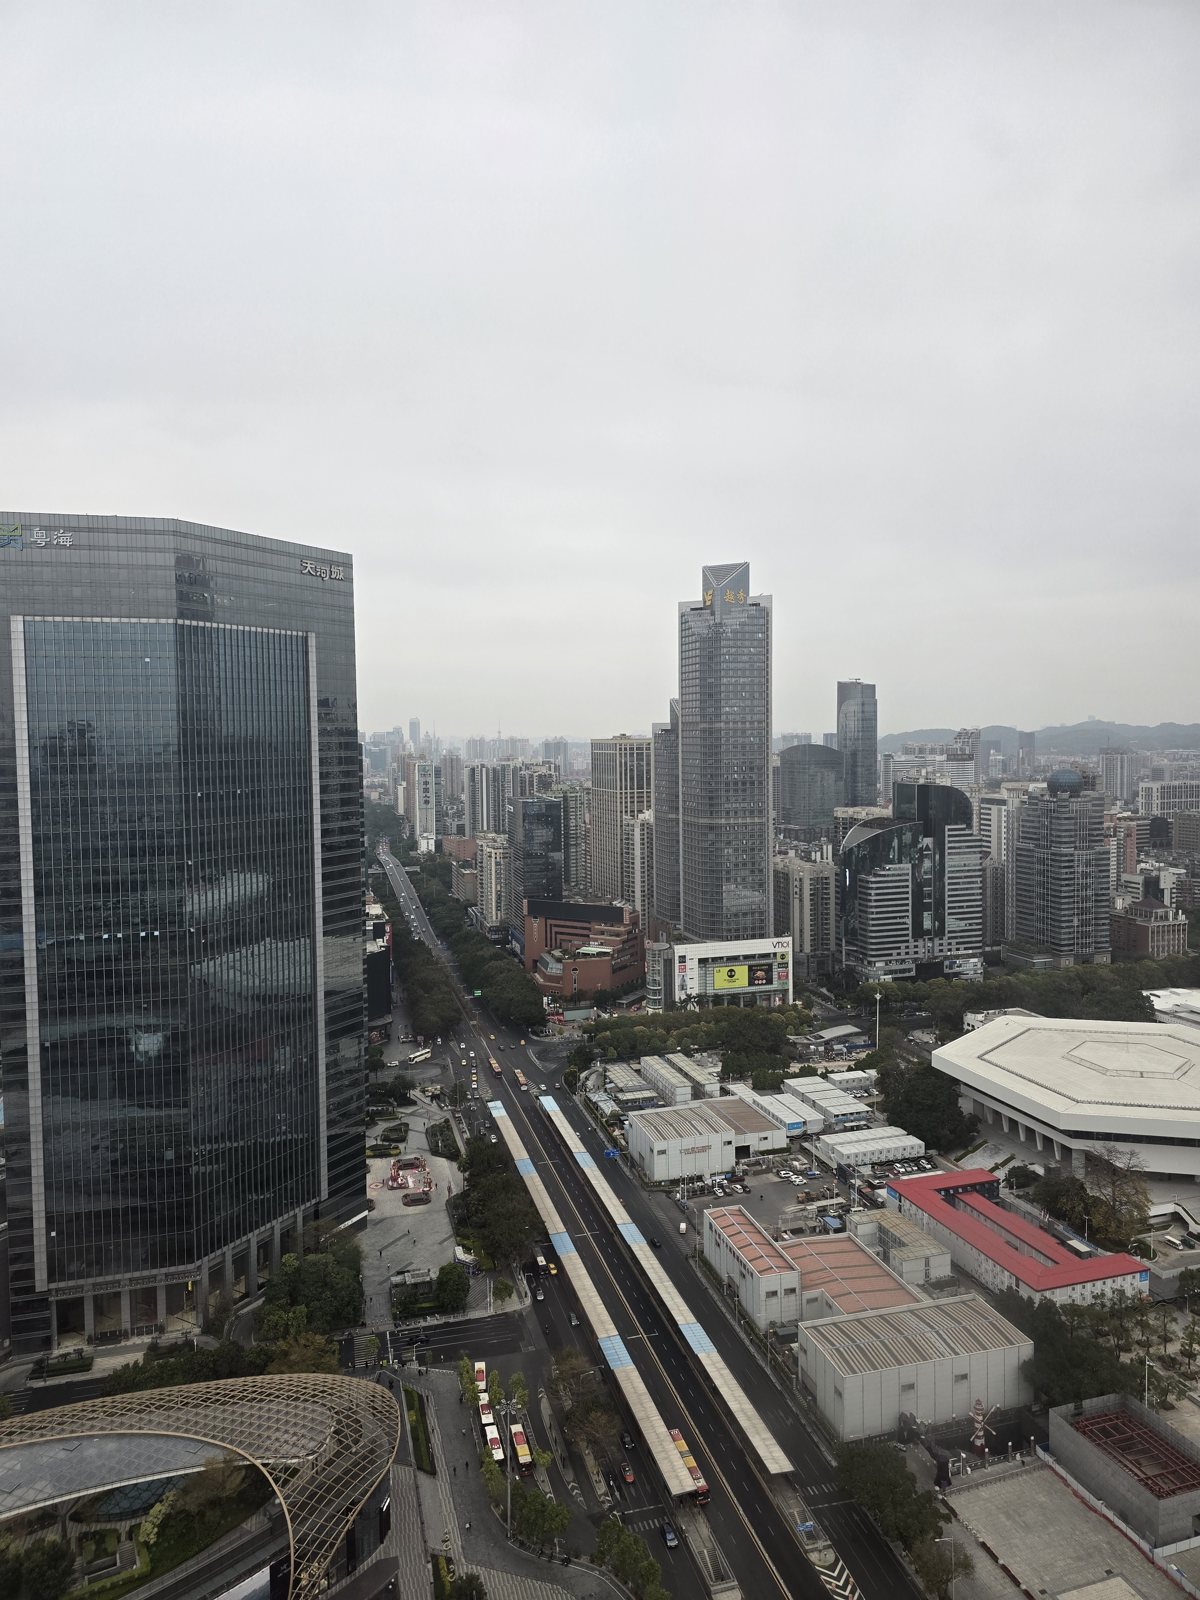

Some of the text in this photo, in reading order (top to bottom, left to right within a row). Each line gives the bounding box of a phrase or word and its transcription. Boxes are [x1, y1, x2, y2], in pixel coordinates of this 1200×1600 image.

[30, 527, 73, 547] 粤海
[301, 559, 345, 580] 天河城
[724, 589, 746, 604] 越秀
